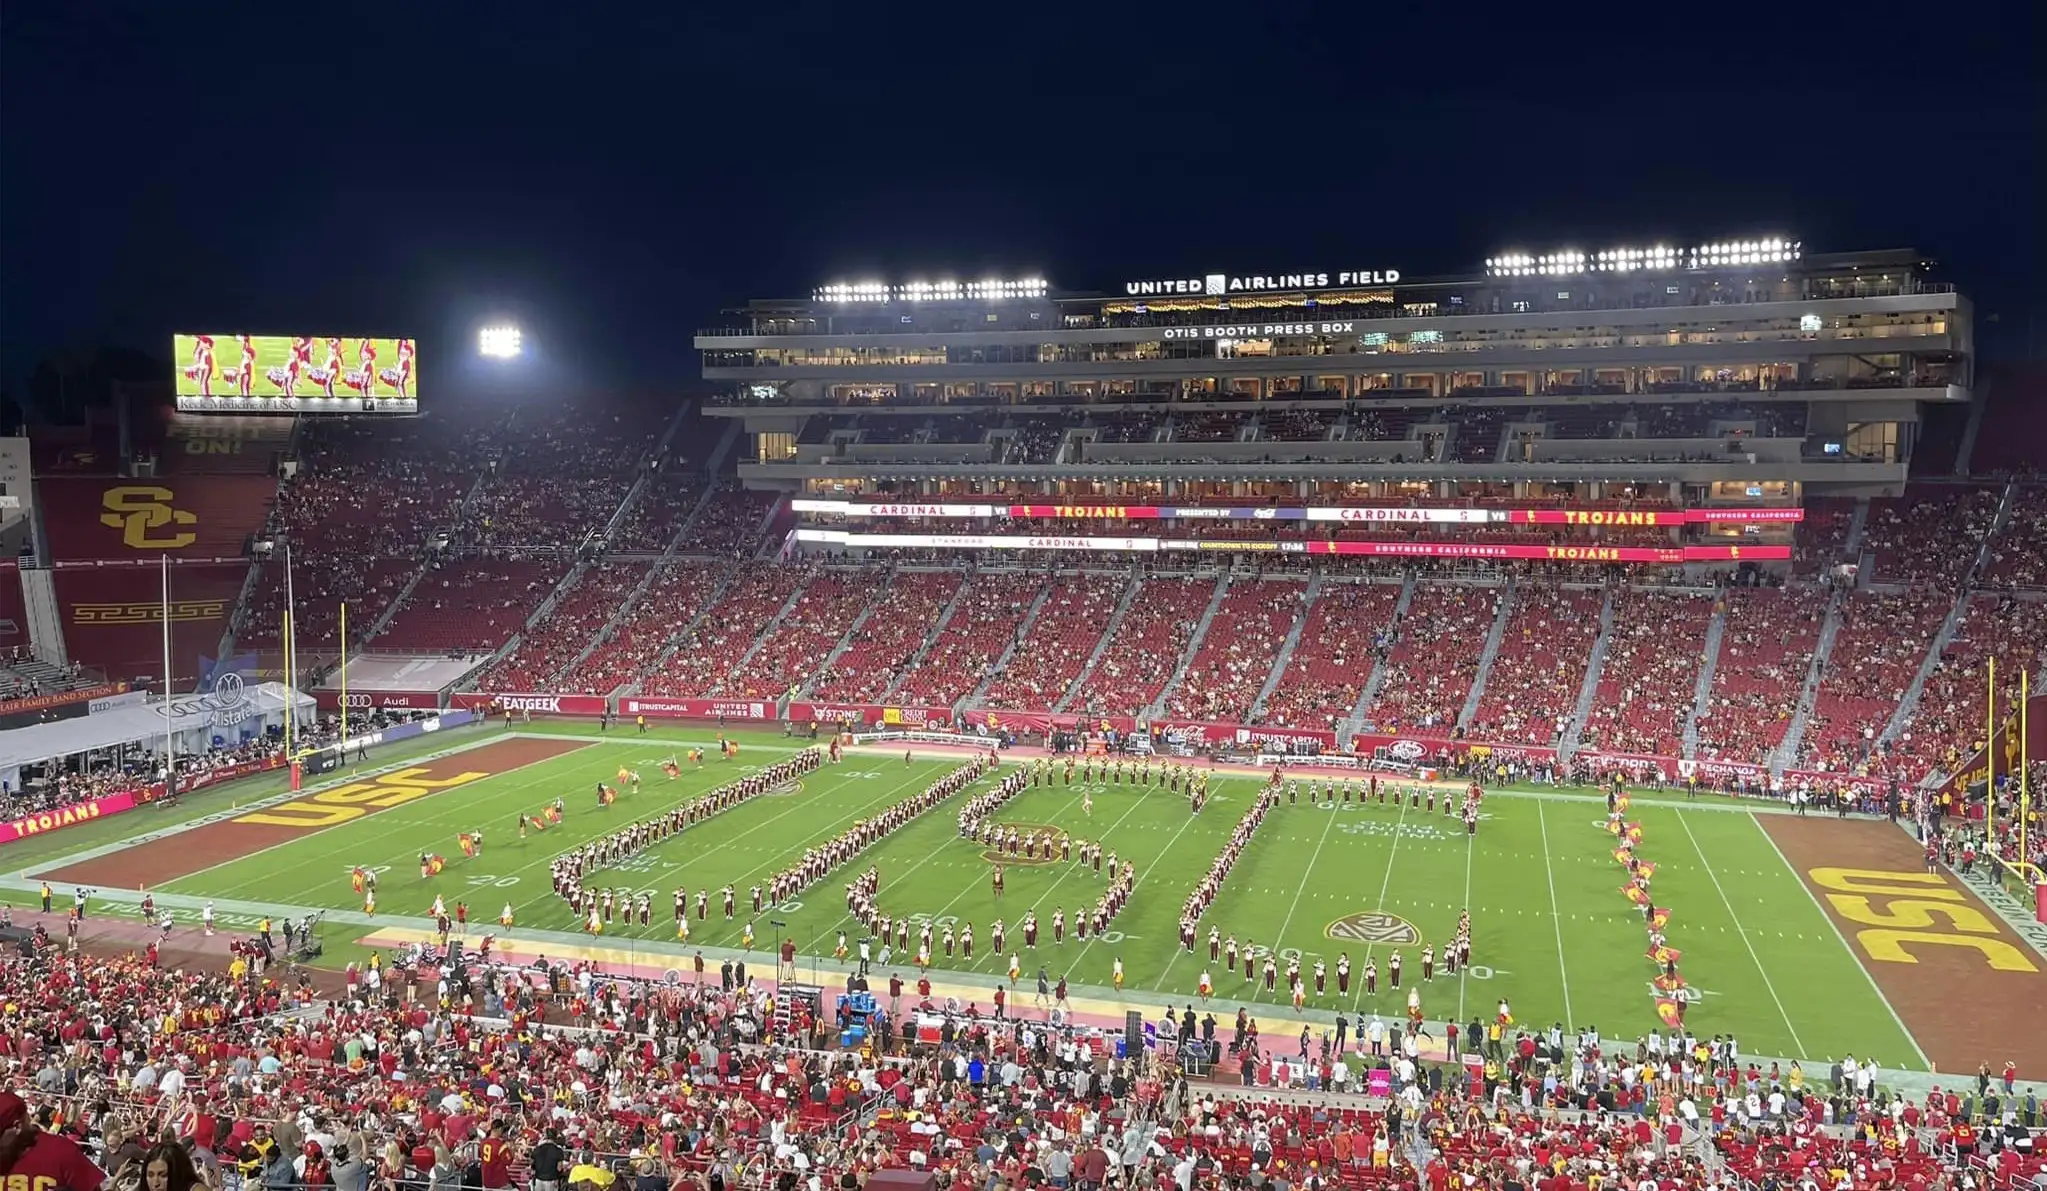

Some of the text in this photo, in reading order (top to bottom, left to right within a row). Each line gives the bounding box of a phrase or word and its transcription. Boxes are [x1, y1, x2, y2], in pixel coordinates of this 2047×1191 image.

[1127, 270, 1400, 295] UNITED AIRLINES FIELD
[1164, 322, 1353, 339] OTIS BOOTH PRESS BOX
[180, 398, 298, 410] Keck Medicine of USC
[186, 439, 241, 454] ON!
[101, 486, 197, 548] SC
[870, 505, 946, 515] CARDINAL
[1054, 506, 1126, 518] TROJANS
[1176, 508, 1231, 517] PRESENTED BY
[1340, 509, 1432, 521] CARDINAL
[1565, 511, 1656, 525] TROJANS
[1028, 539, 1092, 548] CARDINAL
[1375, 545, 1507, 555] SOUTHERN CALIFORNIA
[1547, 547, 1619, 559] TROJANS
[22, 697, 52, 709] FAMILY
[53, 693, 77, 703] BAND
[79, 687, 112, 698] SECTION
[383, 696, 409, 706] Audi
[494, 696, 561, 713] SEATGEEK
[209, 707, 253, 726] Allstate
[705, 709, 748, 717] AIRLINES
[900, 709, 928, 717] CREDIT
[231, 768, 491, 827] USC
[12, 802, 101, 837] TROJANS
[465, 874, 521, 887] 20
[1808, 866, 2040, 972] USC
[483, 1144, 492, 1162] 9
[1448, 1175, 1460, 1190] 14
